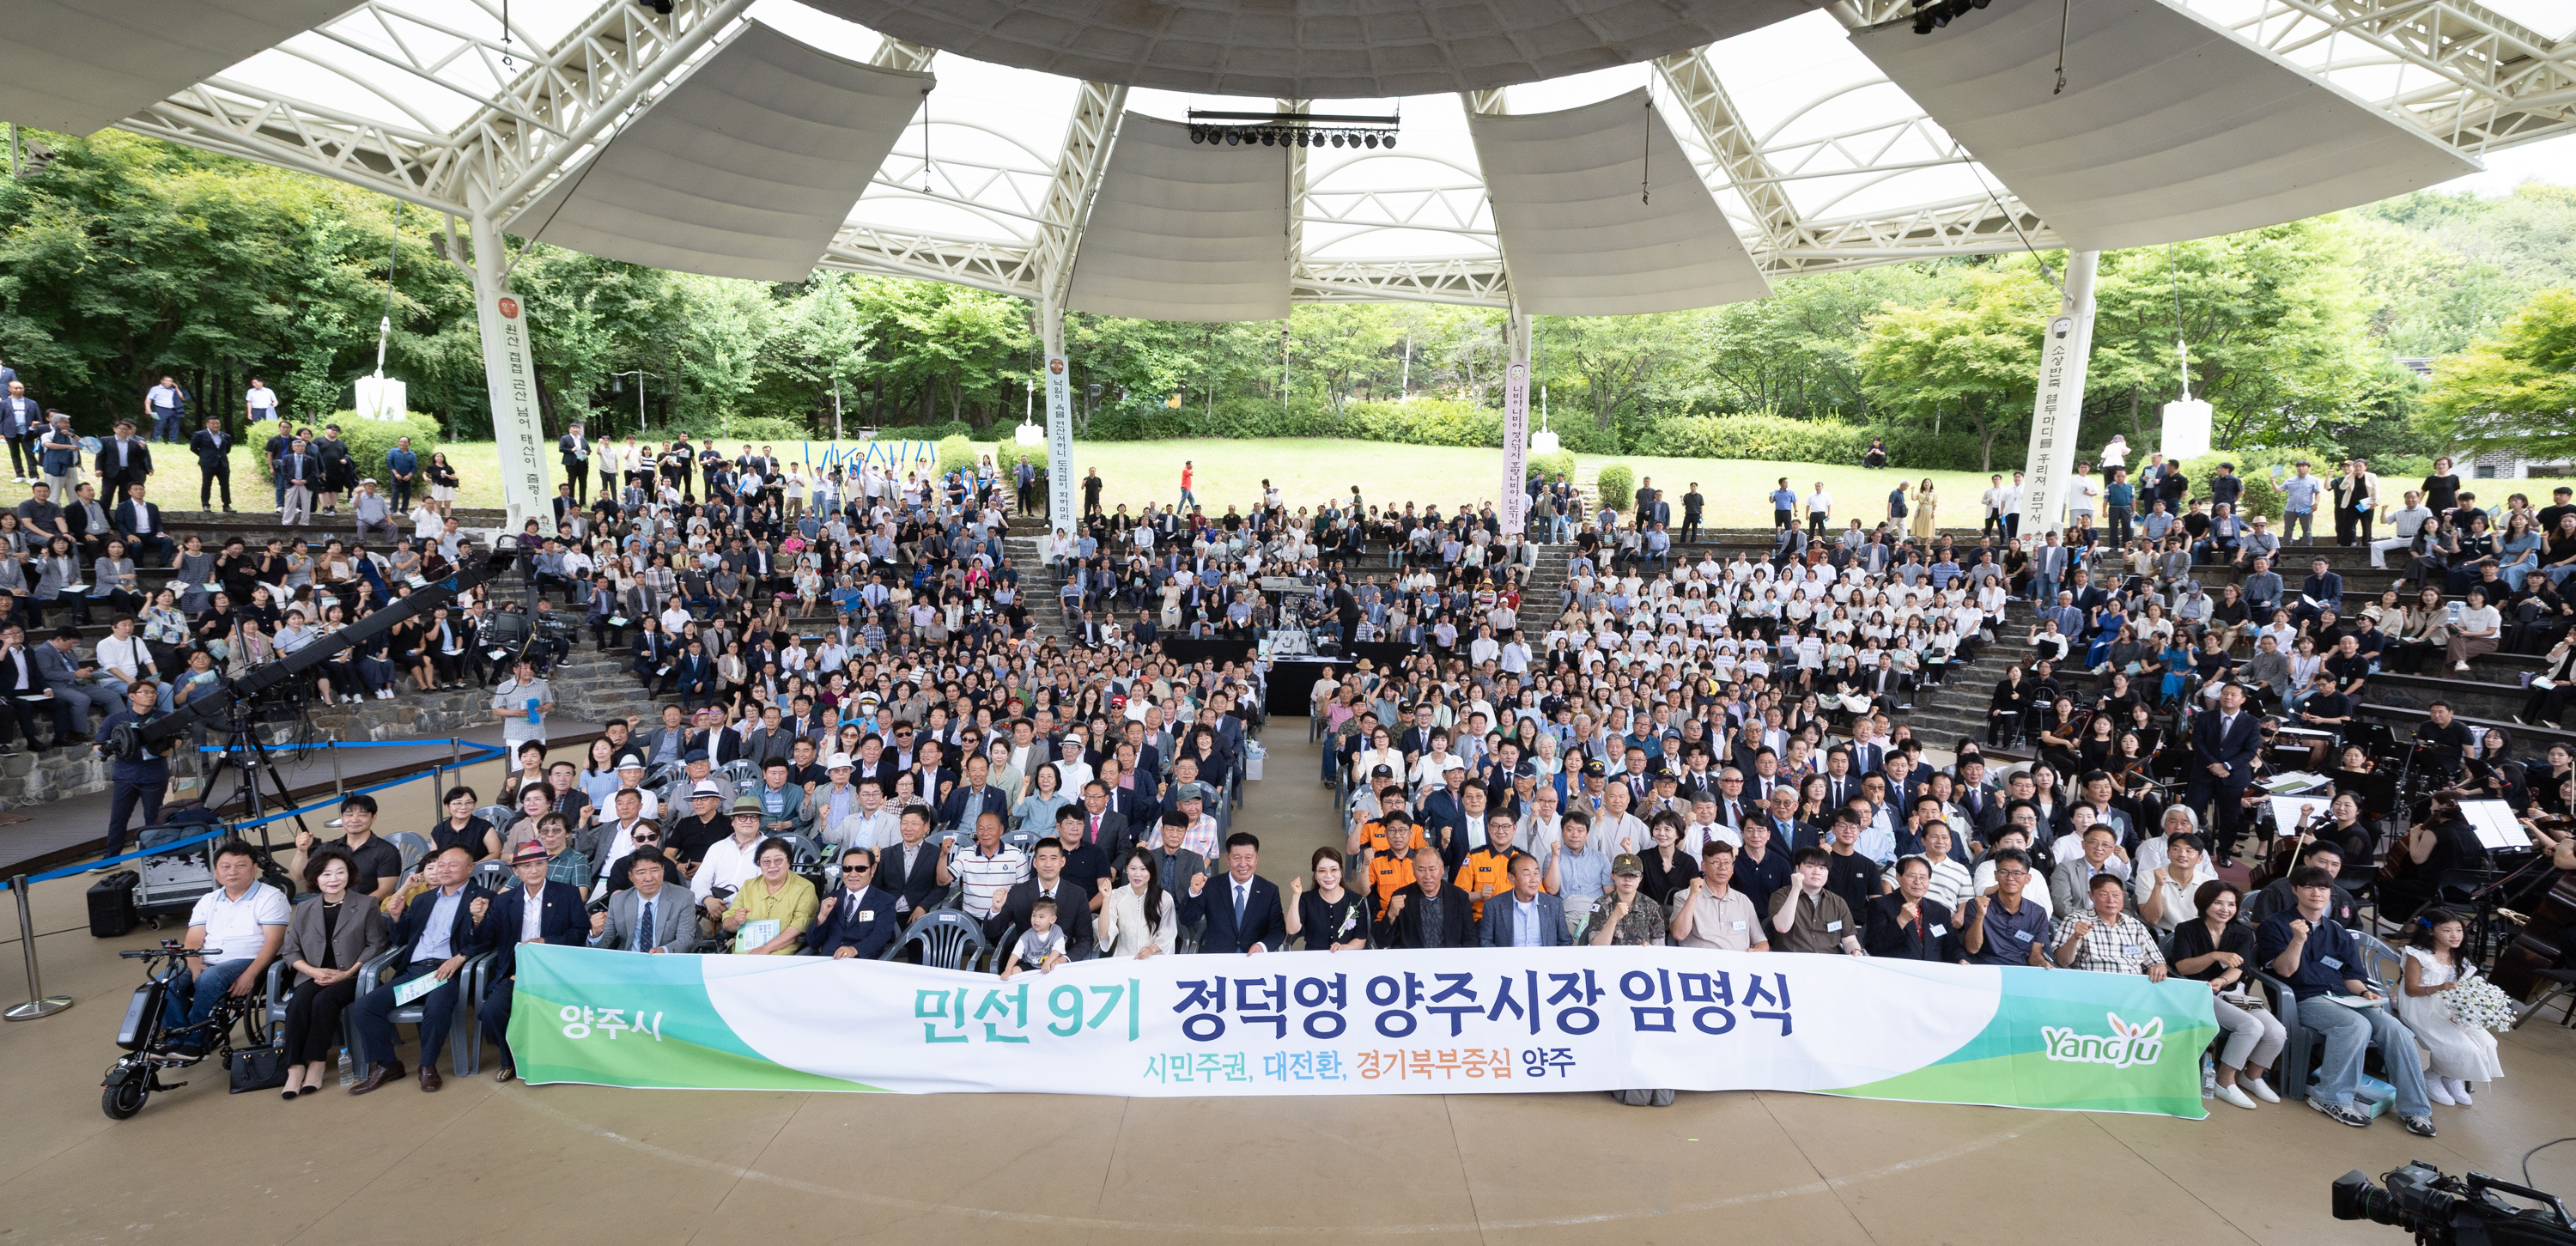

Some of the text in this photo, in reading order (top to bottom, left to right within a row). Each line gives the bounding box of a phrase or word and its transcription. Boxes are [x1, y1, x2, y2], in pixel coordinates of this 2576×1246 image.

[505, 324, 519, 348] 원산
[2047, 345, 2065, 389] 소상반죽
[1053, 379, 1064, 402] 낙일이
[1513, 386, 1523, 407] 나비야
[516, 406, 531, 429] 넘어
[1512, 408, 1522, 430] 나비야
[2039, 393, 2058, 449] 열두마디를
[520, 434, 537, 469] 태산이
[1055, 420, 1066, 458] 현산서하니
[526, 472, 540, 507] 출렁!
[1509, 461, 1521, 497] 호랑나비야
[1059, 491, 1070, 521] 화하미라
[1508, 498, 1519, 527] 너도가자
[2029, 490, 2046, 524] 잡구서
[914, 967, 1793, 1044] 민선 9기 정덕영 양주시장 임명식
[559, 1005, 664, 1042] 양주시
[1143, 1047, 1577, 1084] 시민주권, 대전환, 경기북부중심 양주
